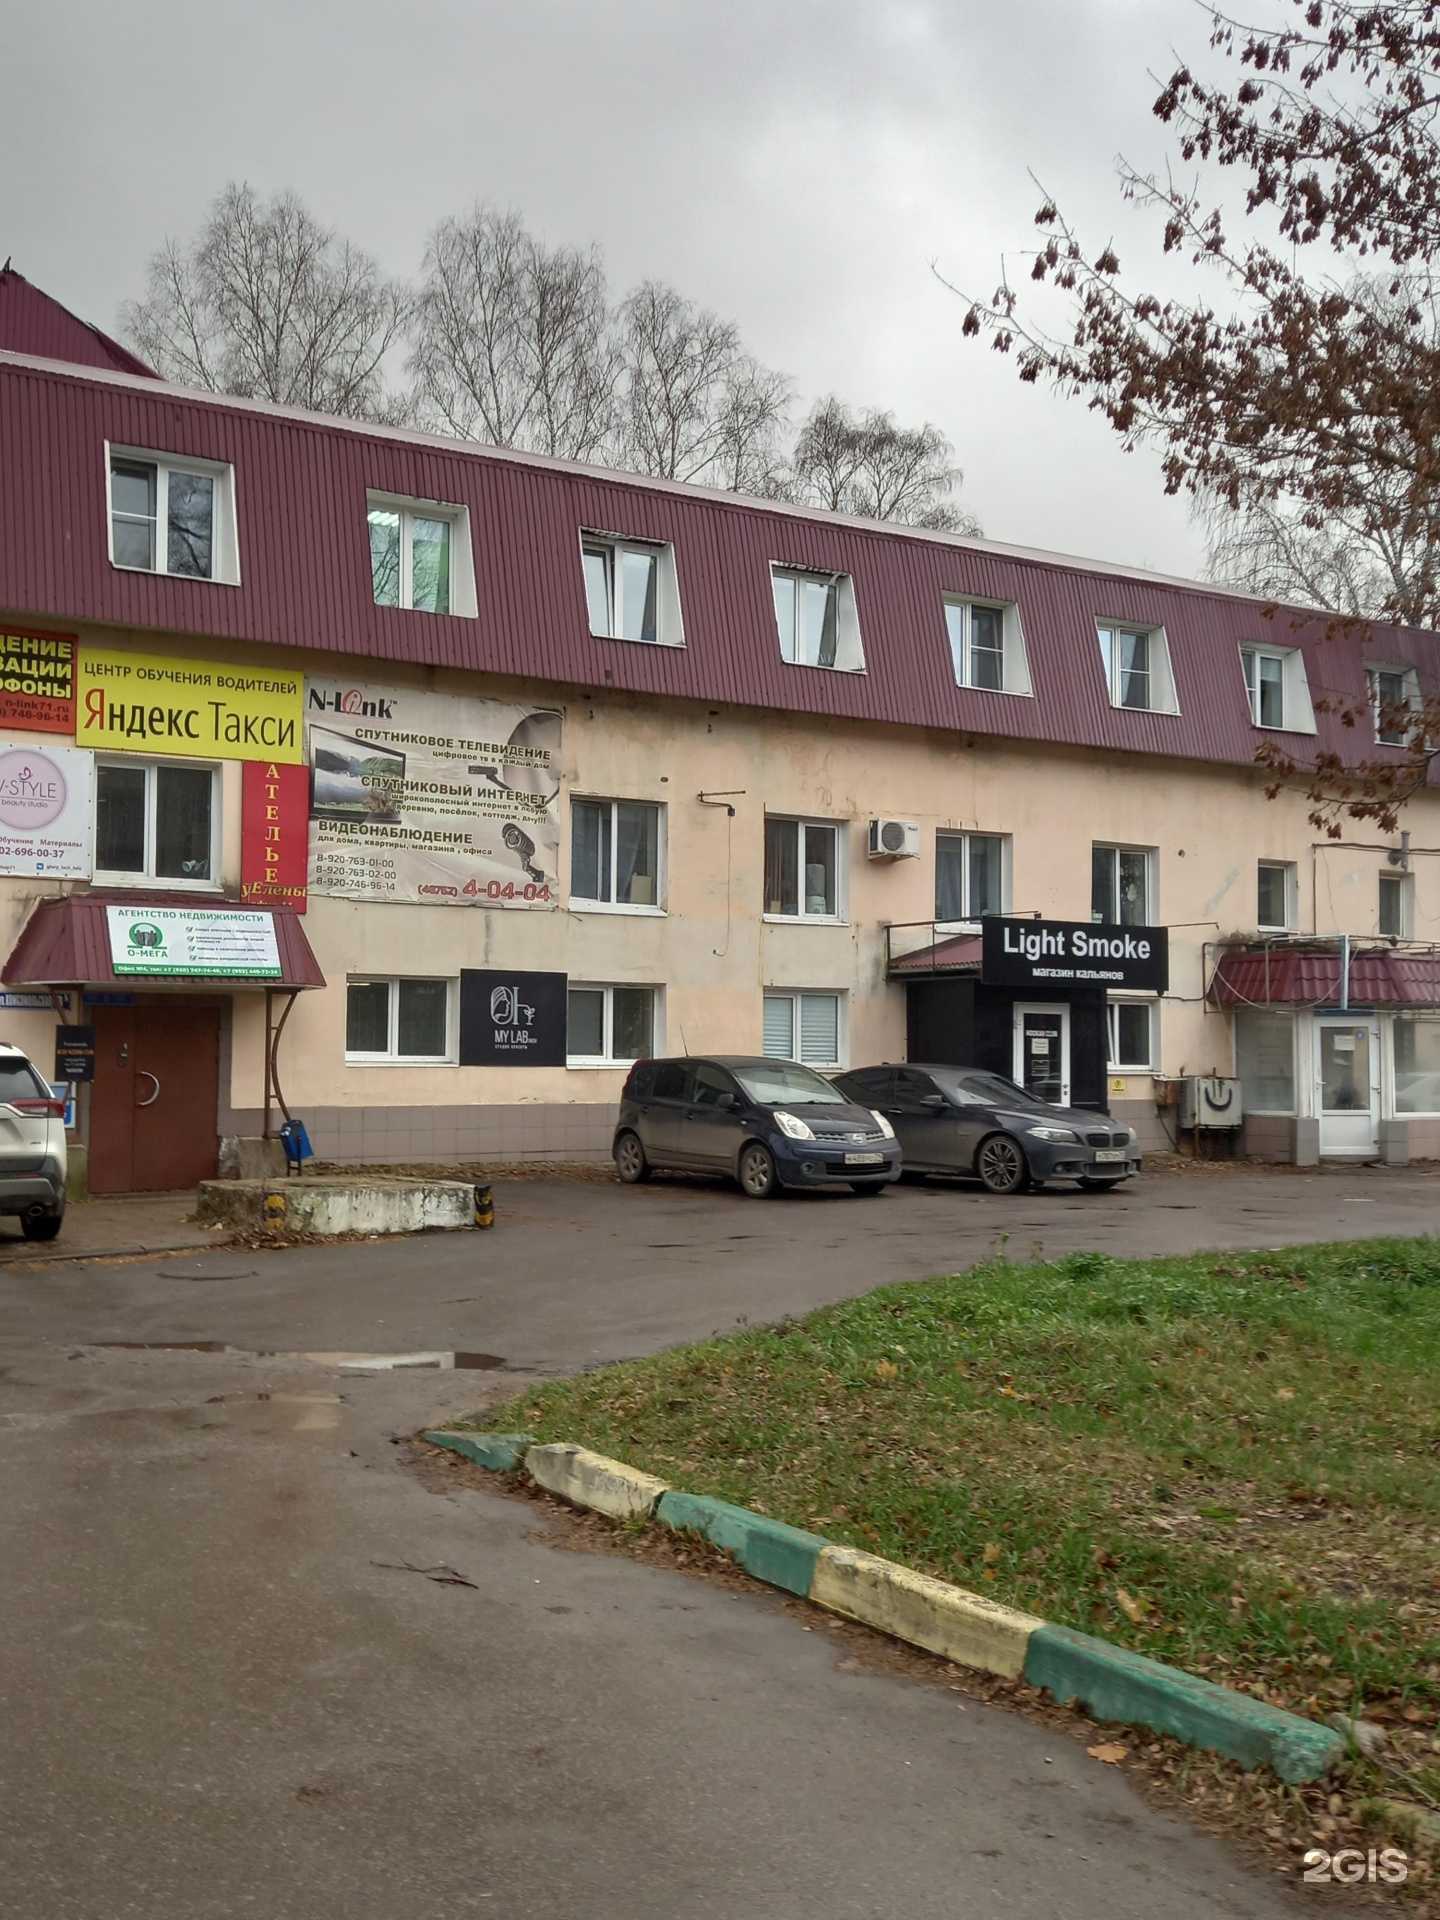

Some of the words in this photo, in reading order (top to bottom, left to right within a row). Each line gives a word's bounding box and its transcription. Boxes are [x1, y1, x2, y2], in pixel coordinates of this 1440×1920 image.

[84, 662, 131, 678] ЦЕНТР
[136, 667, 211, 687] ОБУЧЕНИЯ
[217, 676, 297, 695] ВОДИТЕЛЕЙ
[83, 687, 200, 739] Яндекс
[208, 701, 295, 748] Такси
[355, 727, 454, 748] СПУТНИКОВОЕ
[458, 739, 551, 760] ТЕЛЕВИДЕНИЕ
[432, 750, 477, 762] цифровое
[361, 776, 473, 797] СПУТНИКОВЫЙ
[477, 787, 548, 805] ИНТЕРНЕТ
[391, 793, 469, 806] широкополосный
[472, 801, 511, 811] интернет
[318, 820, 473, 844] ВИДЕОНАБЛЮДЕНИЕ
[40, 839, 82, 848] Материалы
[317, 835, 334, 843] для
[463, 847, 492, 856] офиса
[316, 853, 394, 869] 8-920-763-01-00
[315, 865, 397, 880] 8-920-763-02-00
[315, 876, 396, 891] 8-920-746-96-14
[462, 879, 551, 902] 4-04-04
[118, 909, 177, 919] АГЕНТСТВО
[180, 912, 264, 923] НЕДВИЖИМОСТИ
[1004, 927, 1065, 961] Light
[1071, 930, 1151, 960] Smoke
[127, 949, 168, 958] О-МЕГА
[1032, 968, 1074, 978] магазин
[1076, 969, 1124, 981] кальянов
[494, 1030, 509, 1043] MY
[511, 1030, 529, 1044] LAB
